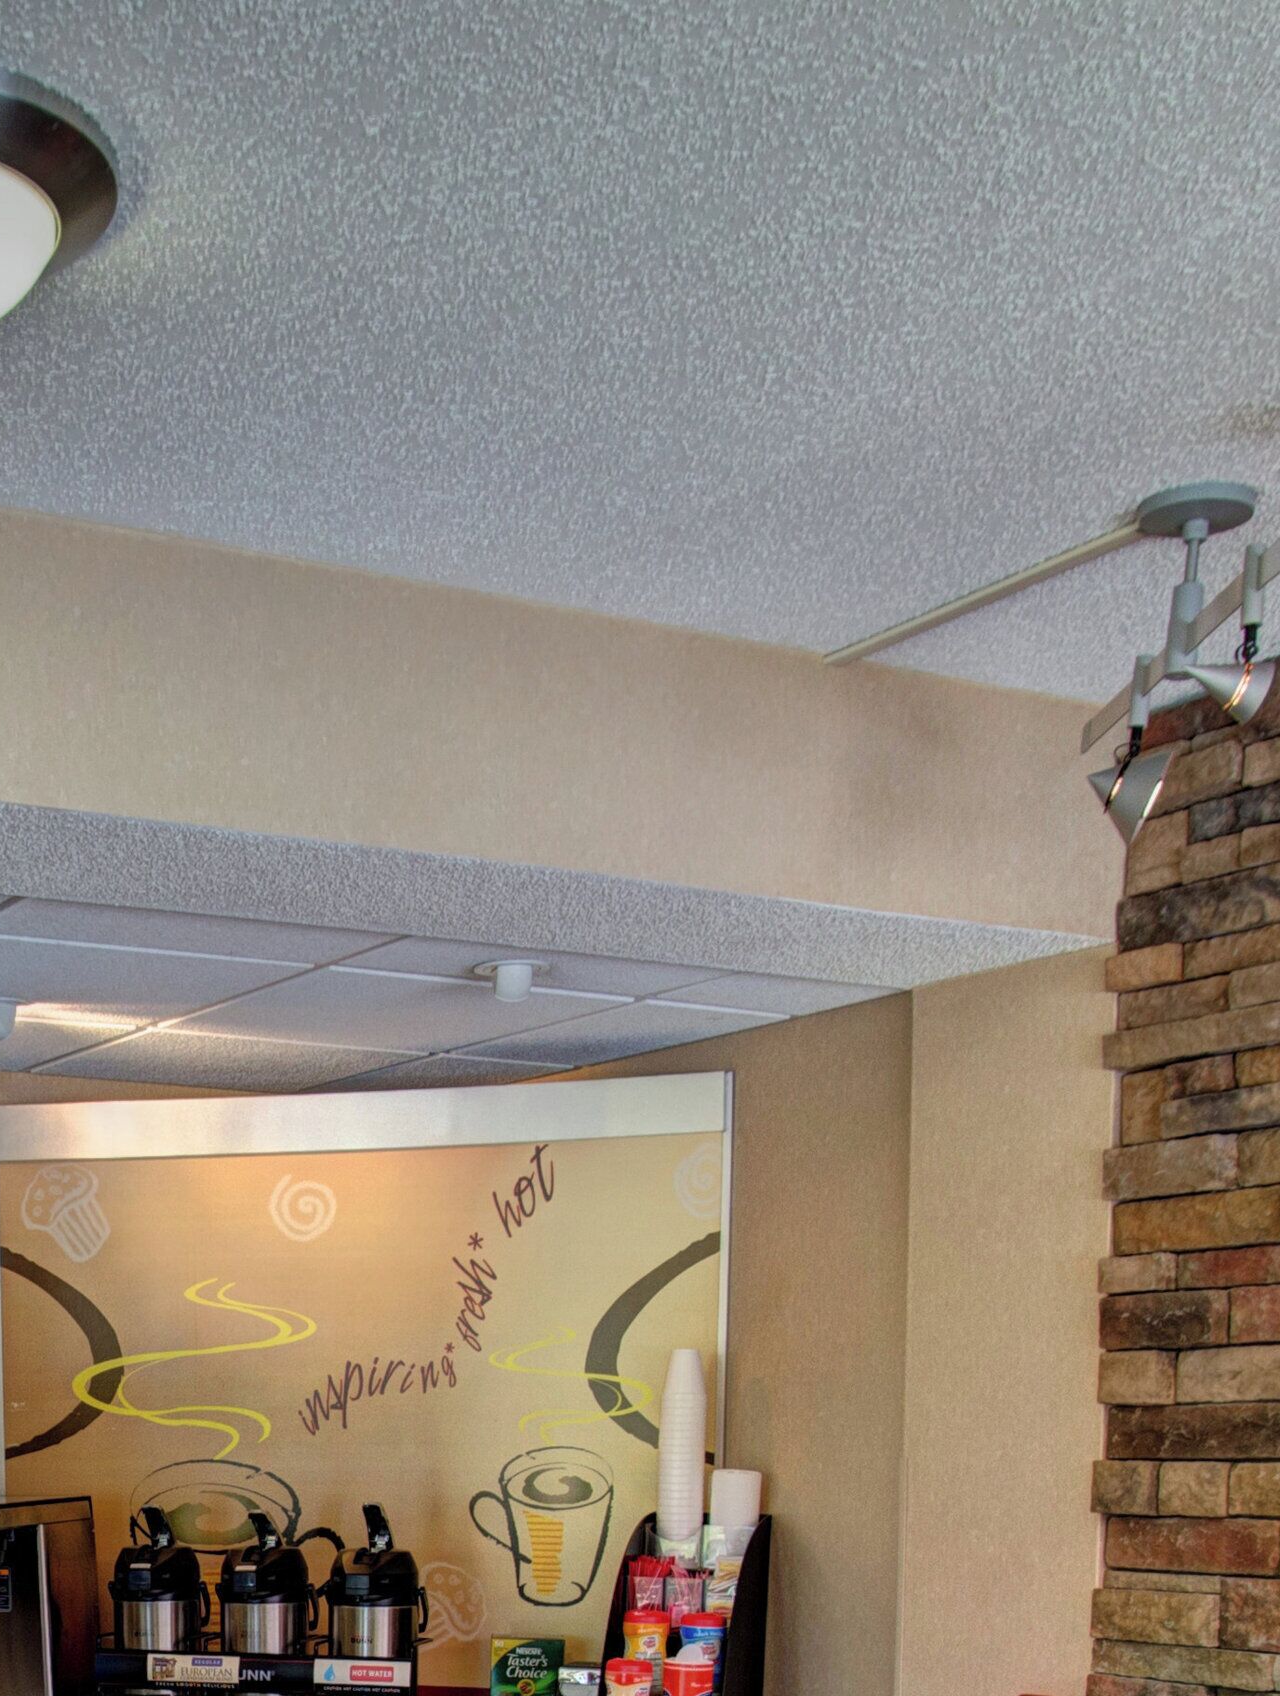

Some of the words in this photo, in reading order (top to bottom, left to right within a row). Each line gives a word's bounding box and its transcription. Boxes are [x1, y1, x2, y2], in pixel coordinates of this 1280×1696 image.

[491, 1144, 555, 1238] hot
[507, 1653, 549, 1667] Taster's
[180, 1667, 234, 1678] EUROPEAN
[238, 1669, 271, 1682] UNN
[351, 1669, 367, 1678] HOT
[368, 1670, 393, 1679] WATER
[506, 1666, 548, 1679] Choice
